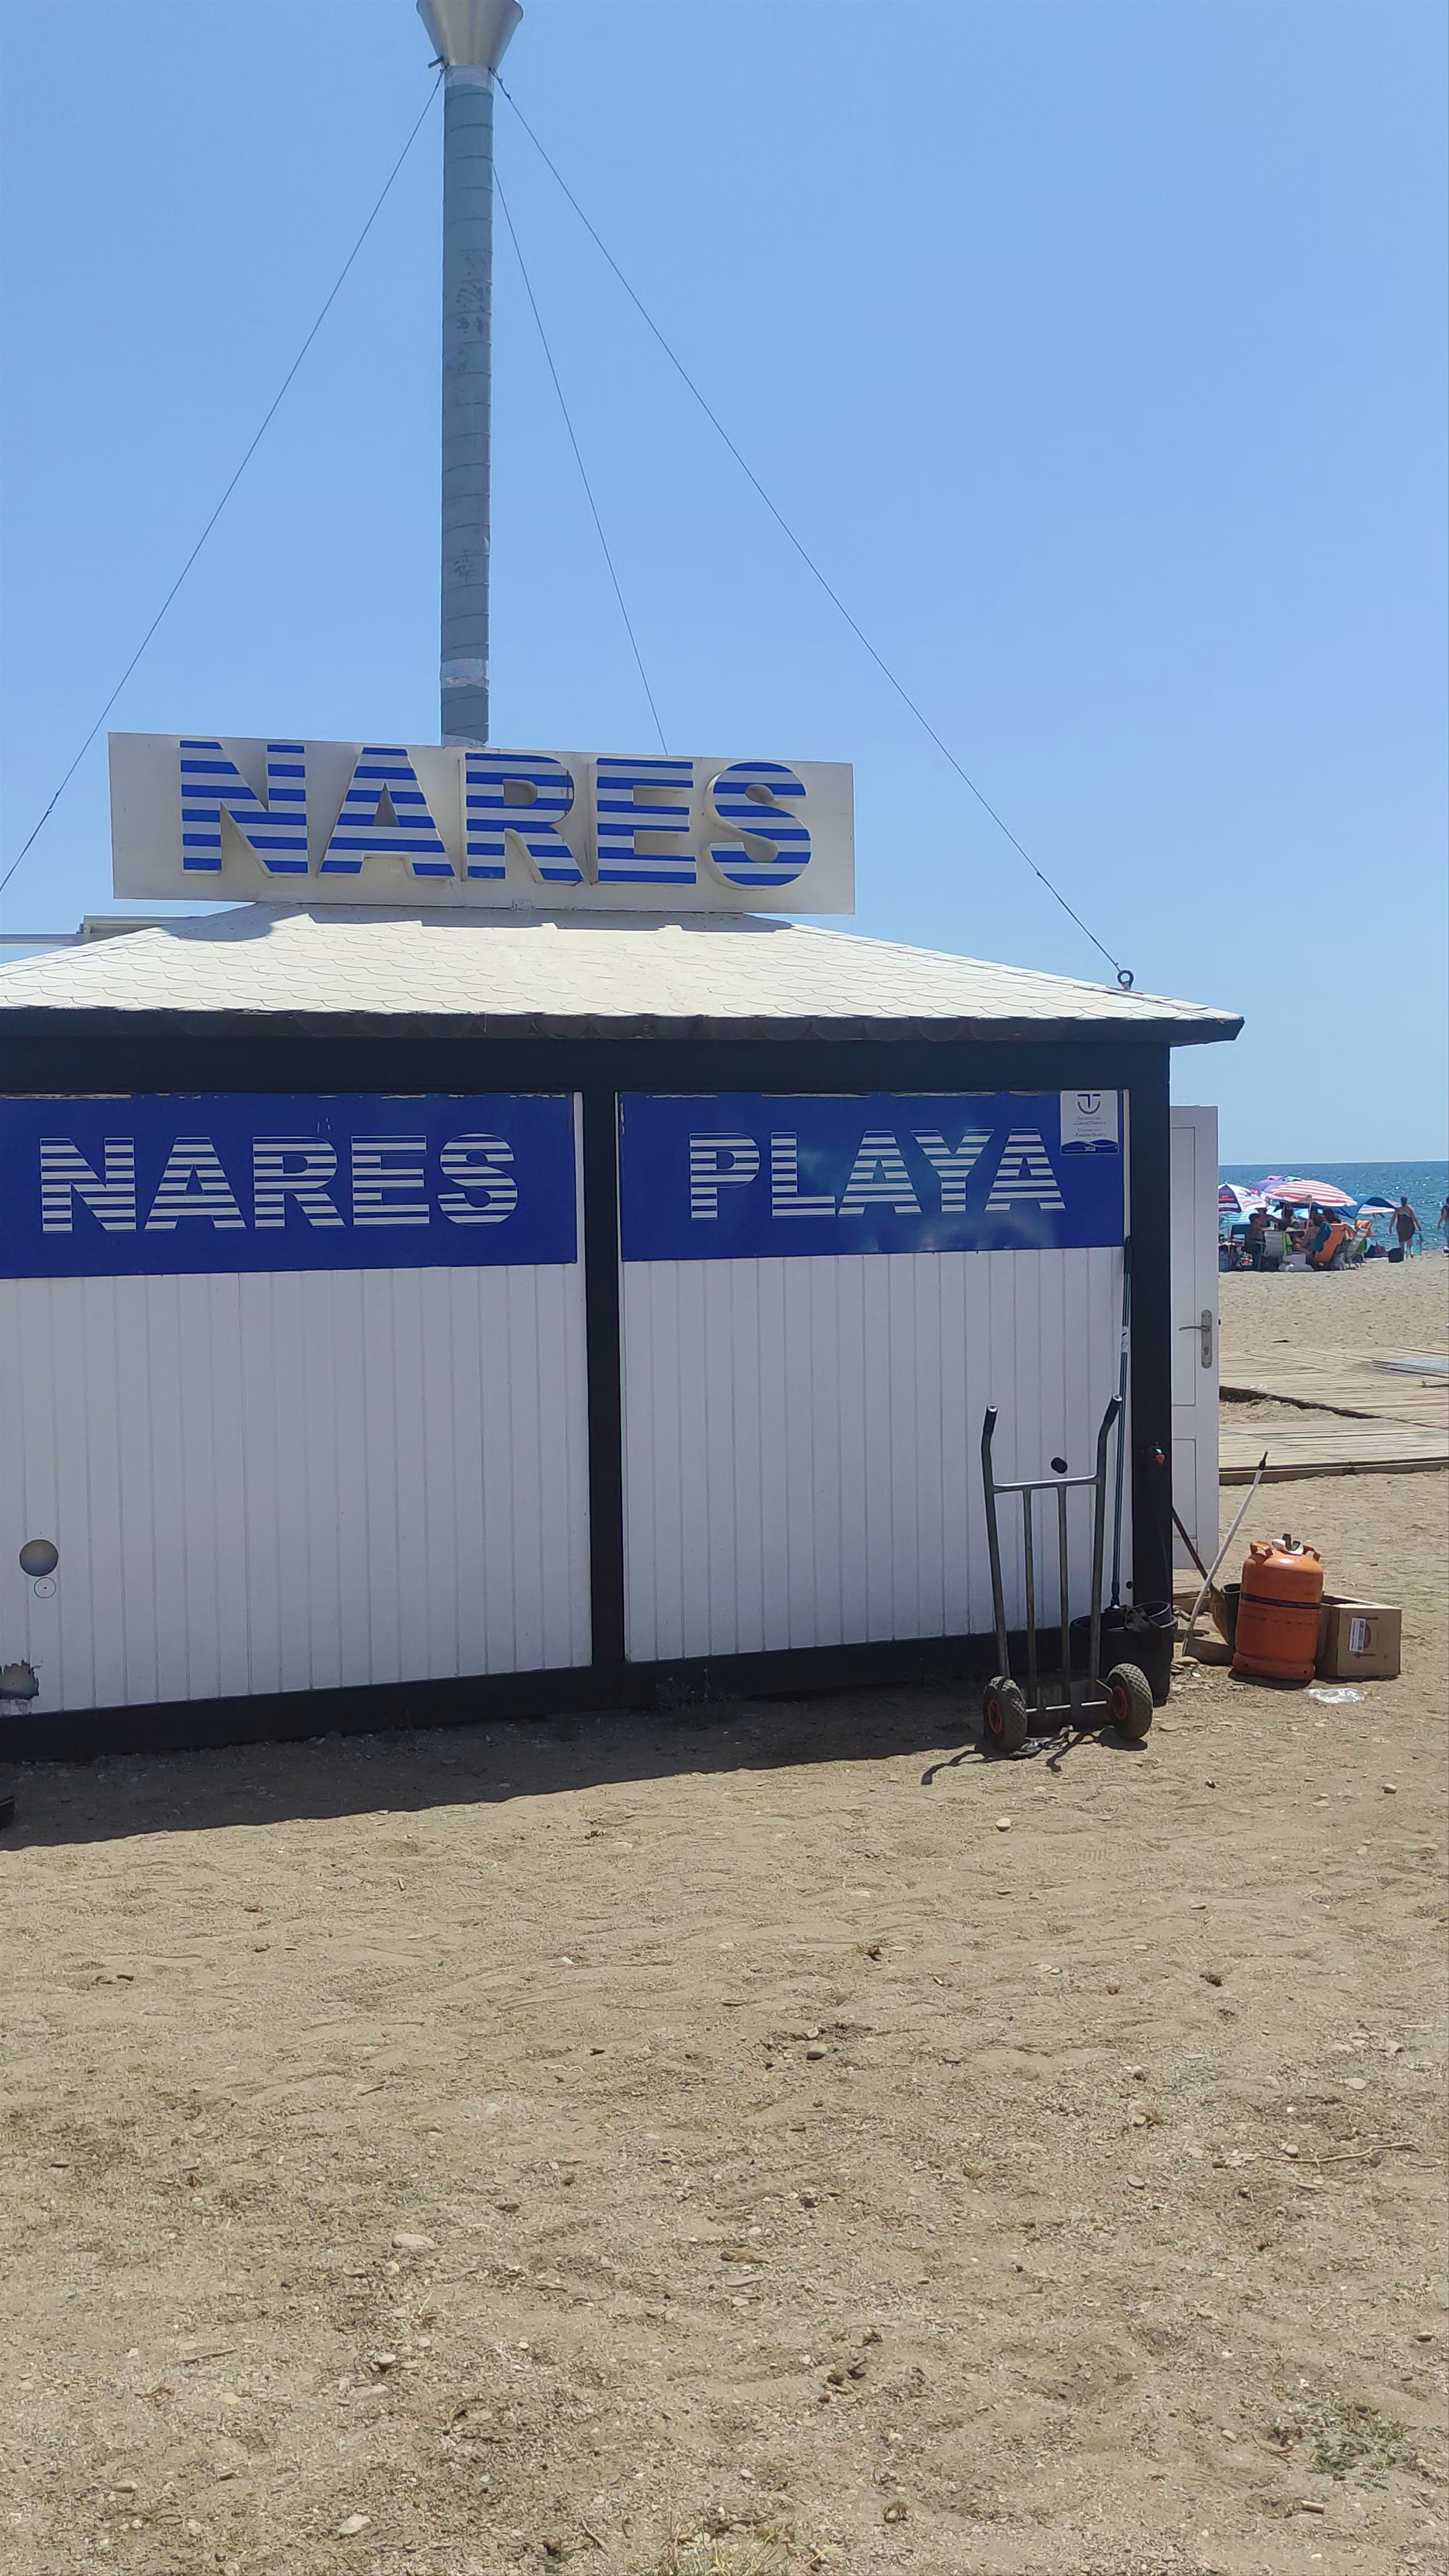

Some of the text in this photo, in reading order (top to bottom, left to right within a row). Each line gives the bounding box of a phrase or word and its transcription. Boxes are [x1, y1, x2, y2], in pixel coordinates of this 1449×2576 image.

[179, 740, 813, 888] NARES
[39, 1133, 518, 1233] NARES
[689, 1128, 1066, 1220] PLAYA
